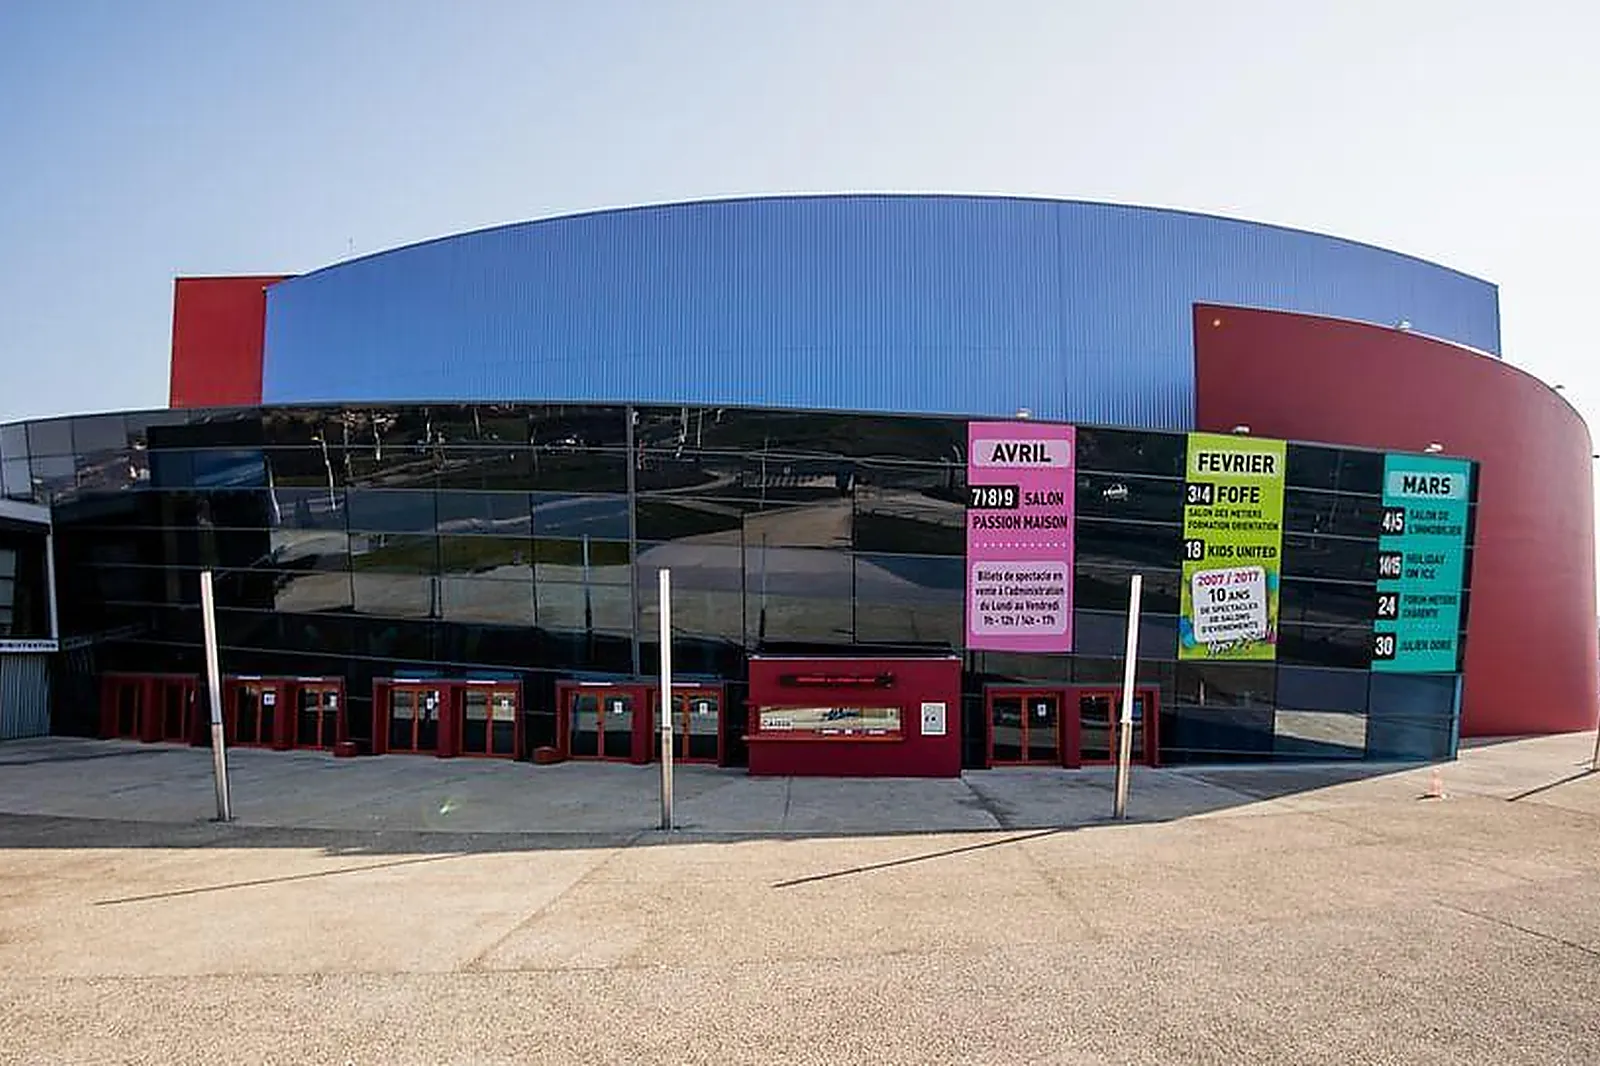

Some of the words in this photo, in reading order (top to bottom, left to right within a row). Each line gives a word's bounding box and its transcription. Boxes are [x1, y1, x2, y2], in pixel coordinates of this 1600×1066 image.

[991, 443, 1051, 462] AVRIL
[1198, 453, 1274, 473] FEVRIER
[1403, 476, 1451, 495] MARS
[1024, 491, 1064, 506] SALON
[1217, 486, 1260, 503] FOFE
[1188, 508, 1212, 517] SALON
[972, 515, 1020, 530] PASSION
[1023, 515, 1068, 530] MAISON
[1188, 521, 1230, 530] FORMATION
[1231, 521, 1278, 530] ORIENTATION
[1185, 541, 1201, 558] 18
[1207, 545, 1234, 557] KIDS
[1236, 546, 1277, 558] UNITED
[978, 571, 1002, 581] Billets
[1004, 571, 1014, 581] de
[1015, 571, 1051, 583] spectacle
[1197, 574, 1225, 587] 2007
[1235, 571, 1259, 583] 2017
[1406, 568, 1419, 578] ON
[1421, 568, 1436, 579] ICE
[1208, 588, 1226, 602] 10
[1228, 589, 1250, 600] ANS
[992, 601, 1013, 611] Lundi
[1025, 601, 1060, 611] Vendredi
[1378, 596, 1396, 616] 24
[1375, 636, 1393, 655] 30
